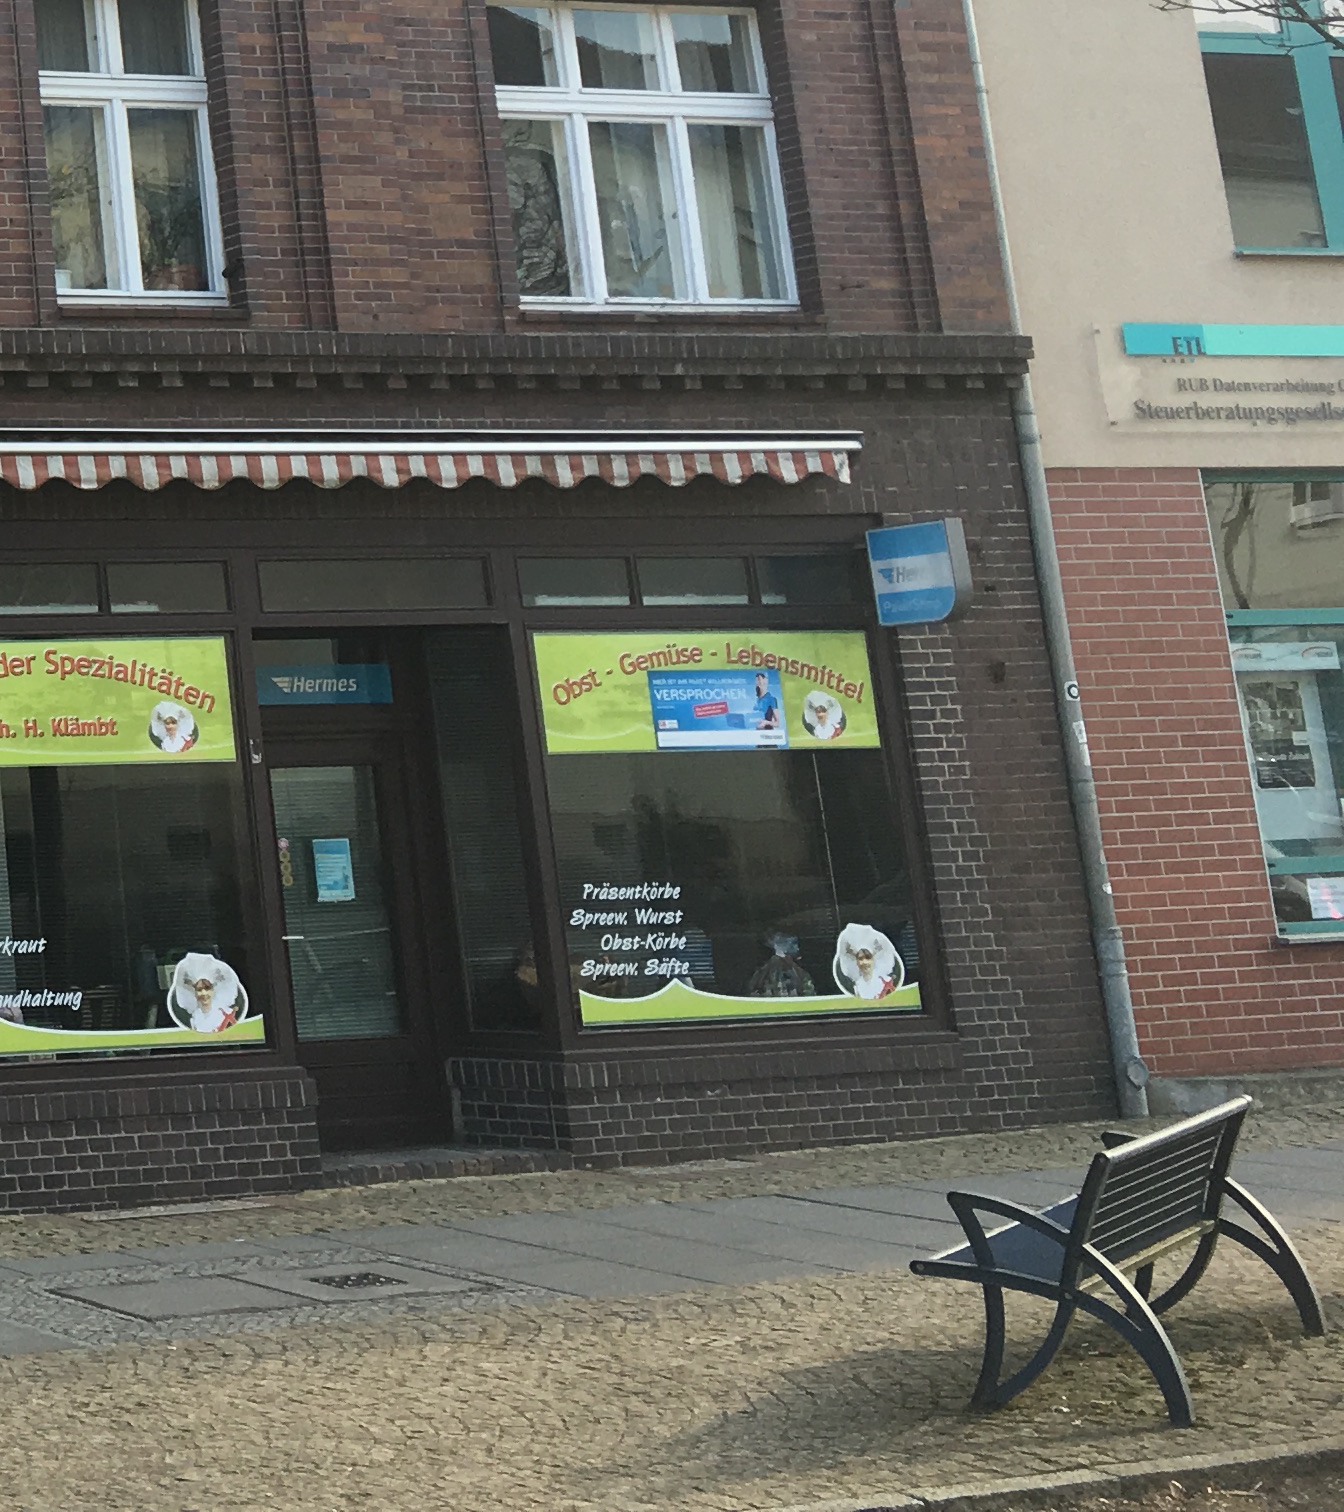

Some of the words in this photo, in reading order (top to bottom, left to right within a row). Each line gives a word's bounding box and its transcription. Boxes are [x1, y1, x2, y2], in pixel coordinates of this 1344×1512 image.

[1172, 336, 1207, 356] ETL
[1176, 377, 1210, 393] RUB
[44, 648, 216, 714] Spezialitäten
[552, 668, 602, 706] Obst
[618, 643, 703, 675] Gemüse
[725, 641, 865, 704] Lebensmittel
[293, 676, 358, 693] Hermes
[23, 717, 45, 738] H.
[50, 715, 119, 737] Klämbt
[583, 882, 681, 901] Präsentkörbe
[570, 908, 628, 930] Spreew.
[634, 907, 684, 925] Wurst
[600, 932, 687, 951] Obst-Körbe
[580, 959, 639, 981] Spreew.
[644, 957, 690, 978] Säfte
